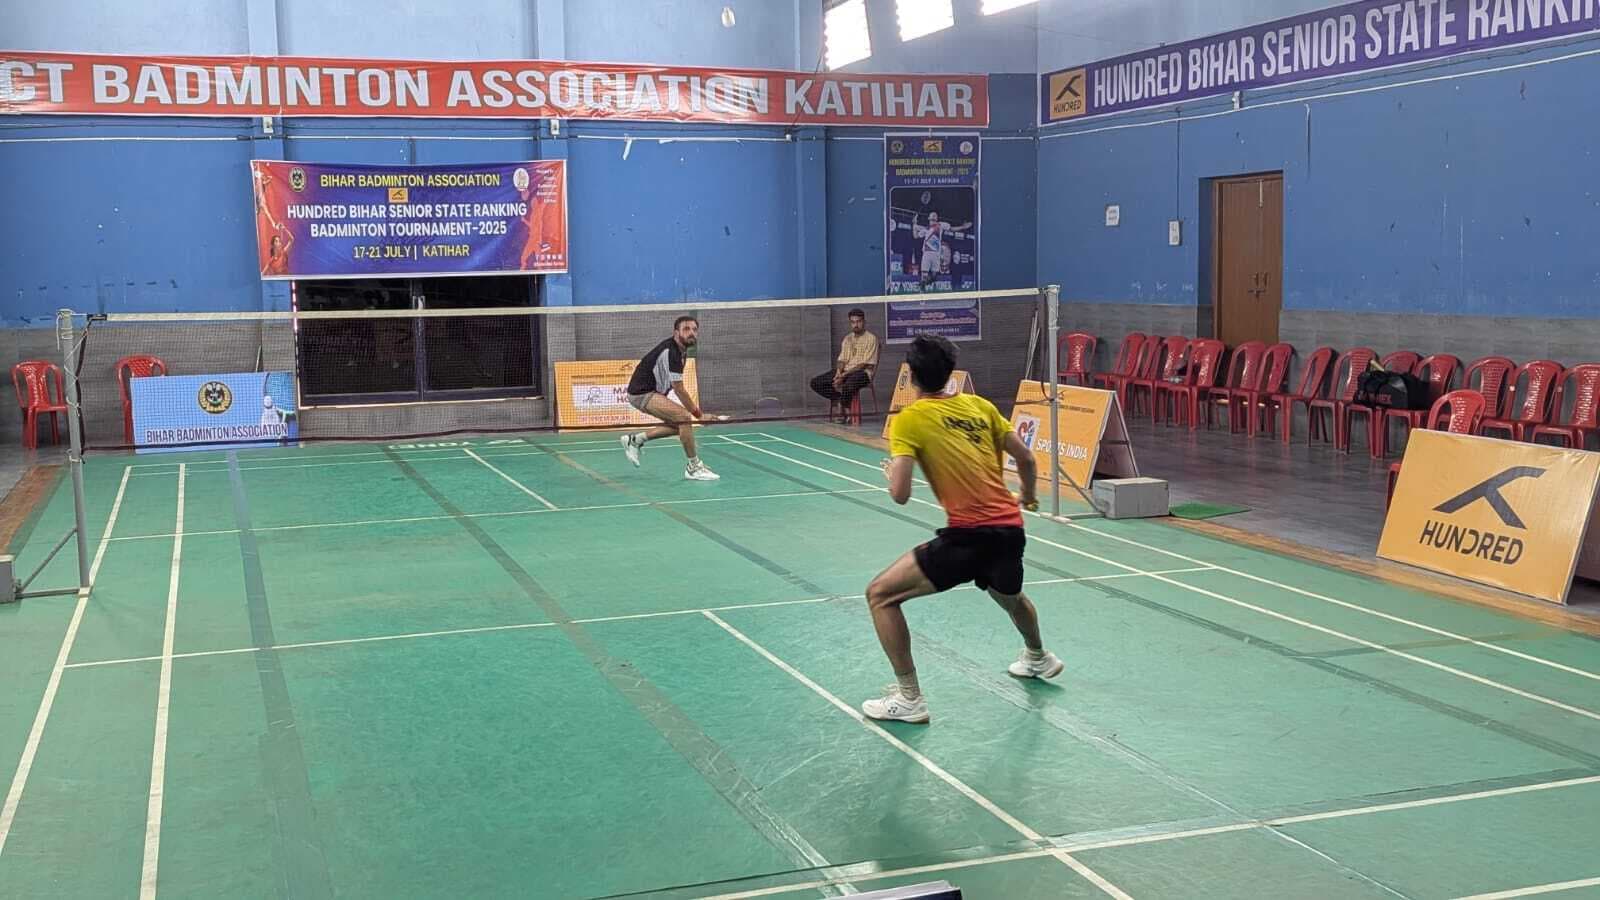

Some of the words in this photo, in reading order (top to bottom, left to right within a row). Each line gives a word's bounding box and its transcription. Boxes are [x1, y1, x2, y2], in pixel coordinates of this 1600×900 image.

[1094, 50, 1182, 108] HUNDRED
[1188, 36, 1255, 90] BIHAR
[1262, 14, 1357, 77] SENIOR
[1364, 0, 1457, 58] STATE
[93, 63, 429, 108] BADMINTON
[446, 70, 769, 116] ASSOCIATION
[785, 78, 974, 119] KATIHAR
[1053, 99, 1082, 113] HUNDRED
[320, 174, 355, 187] BIHAR
[359, 174, 425, 187] BADMINTON
[427, 173, 500, 187] ASSOCIATION
[287, 204, 347, 218] HUNDRED
[349, 204, 387, 218] BIHAR
[388, 204, 433, 217] SENIOR
[435, 203, 471, 217] STATE
[473, 202, 527, 217] RANKING
[310, 222, 387, 237] BADMINTON
[353, 246, 382, 258] 17-21
[383, 245, 411, 258] JULY
[422, 244, 470, 257] KATIHAR
[146, 429, 175, 443] BIHAR
[176, 426, 229, 442] BADMINTON
[232, 422, 288, 439] ASSOCIATION
[1036, 438, 1066, 456] SPOTS
[1066, 442, 1088, 461] INDIA
[1419, 519, 1524, 565] HUNDRED
